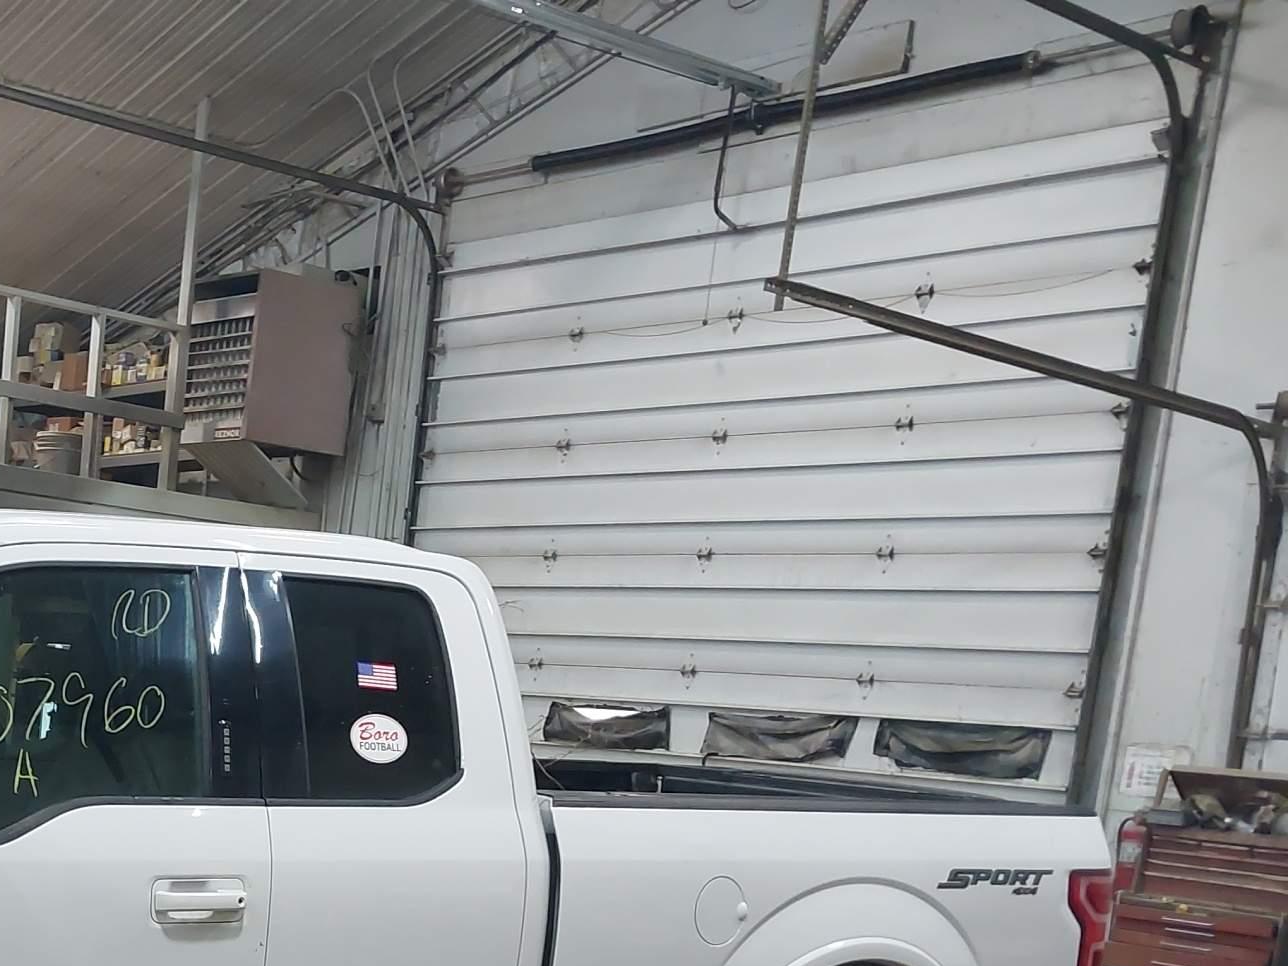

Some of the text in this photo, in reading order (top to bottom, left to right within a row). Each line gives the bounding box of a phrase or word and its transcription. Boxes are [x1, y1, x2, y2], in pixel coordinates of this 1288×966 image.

[358, 722, 398, 741] Boro
[359, 741, 401, 752] FOOTBALL
[936, 868, 1053, 889] SPORT
